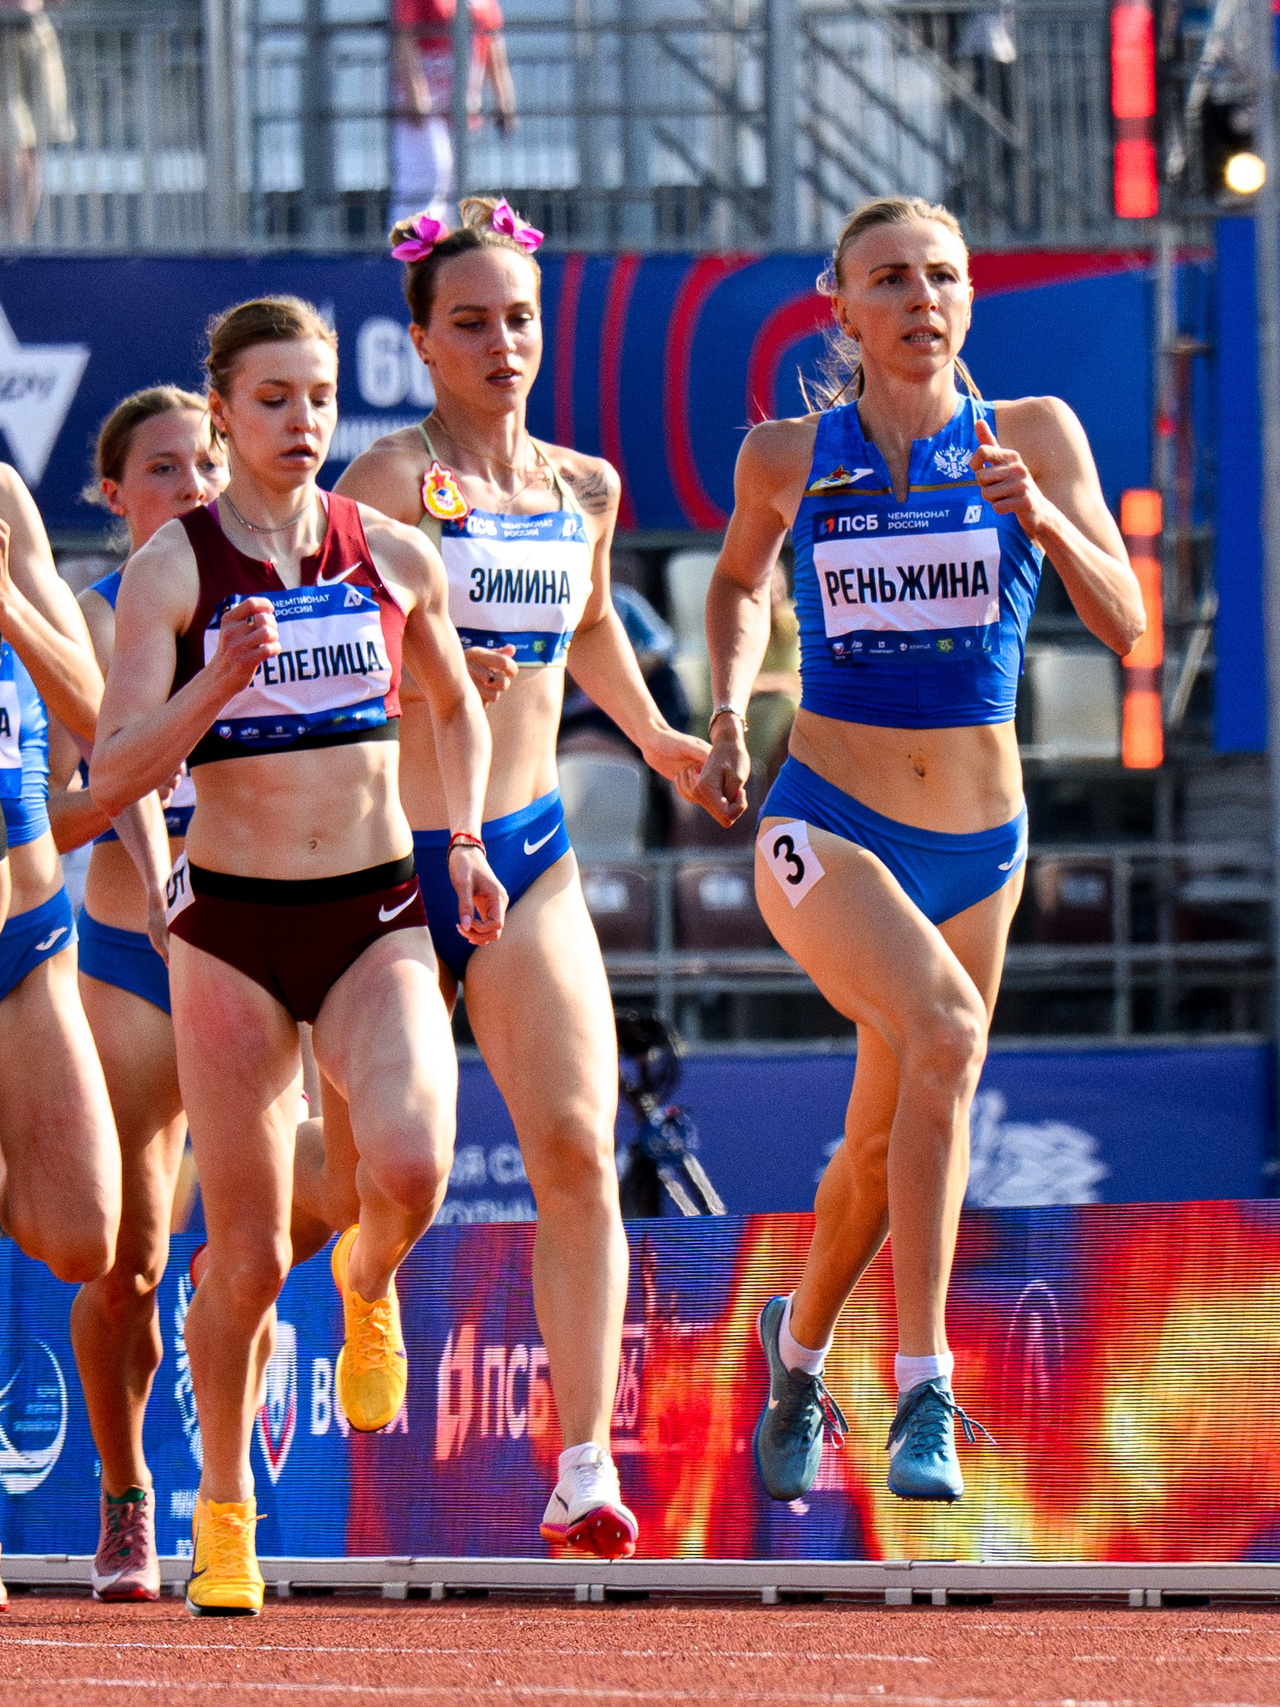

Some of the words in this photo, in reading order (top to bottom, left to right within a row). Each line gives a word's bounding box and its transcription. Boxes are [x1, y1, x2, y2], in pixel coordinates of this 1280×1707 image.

[838, 513, 879, 533] ПСБ
[887, 509, 950, 519] ЧЕМПИОНАТ
[887, 520, 929, 530] РОССИИ
[469, 567, 571, 605] ЗИМИНА
[824, 560, 989, 607] РЕНЬЖИНА
[271, 594, 330, 608] ЧЕМПИОНАТ
[275, 605, 314, 617] РОССИИ
[249, 641, 384, 688] ЕПЕЛИЦА
[773, 834, 805, 885] 3
